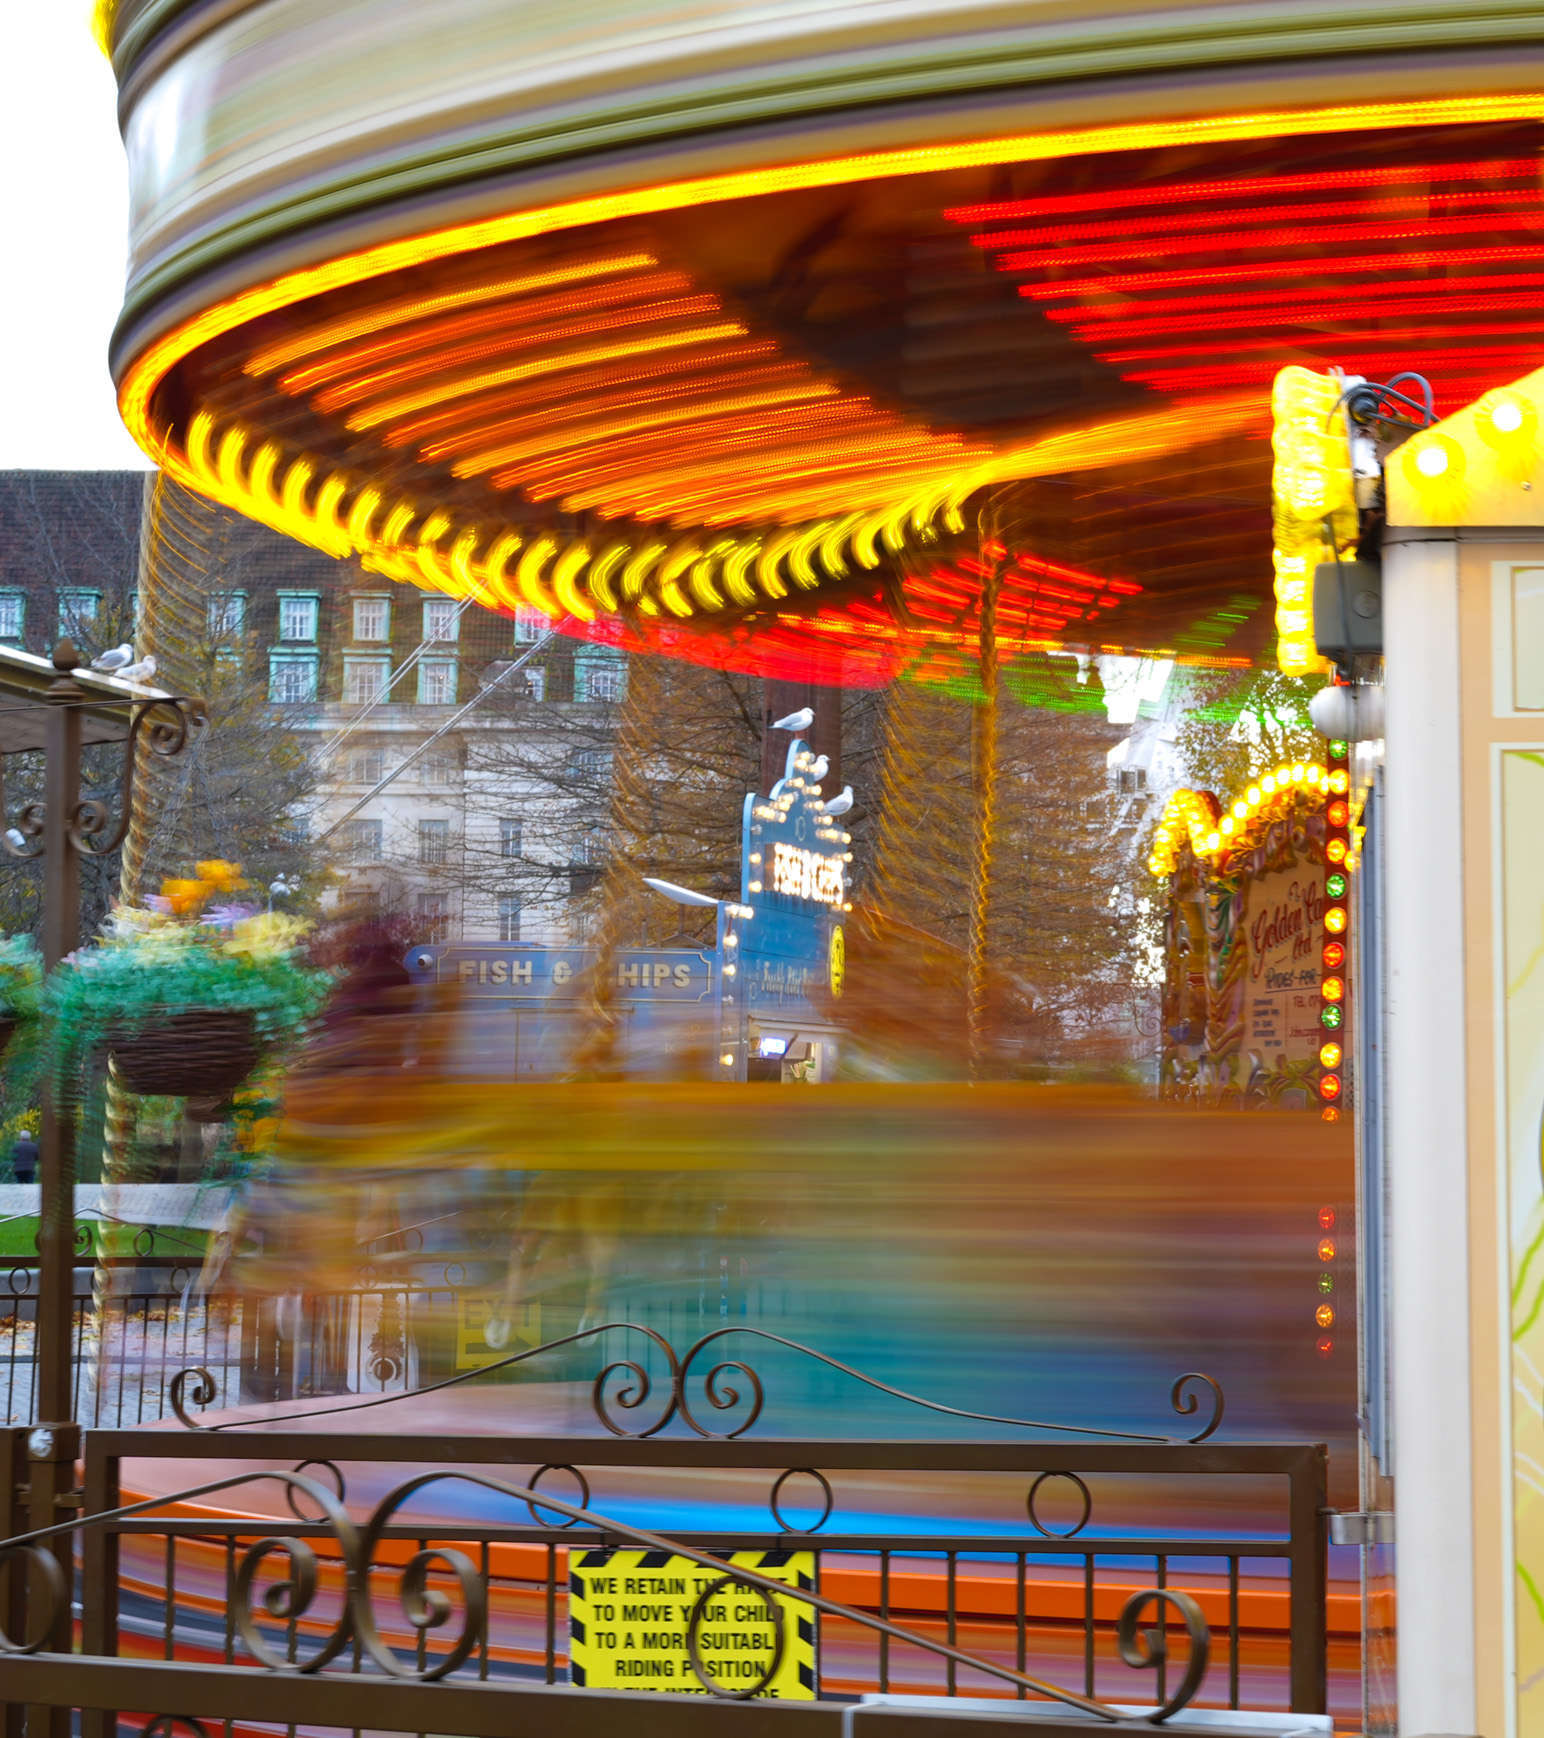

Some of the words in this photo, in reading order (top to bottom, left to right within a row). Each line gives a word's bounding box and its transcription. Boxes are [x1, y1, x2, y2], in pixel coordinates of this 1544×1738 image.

[458, 960, 532, 985] FISH
[553, 960, 573, 985] &
[616, 963, 691, 988] HIPS
[464, 1299, 537, 1330] EXT
[590, 1577, 617, 1595] WE
[625, 1577, 686, 1595] RETAIN
[593, 1605, 617, 1622] TO
[622, 1605, 673, 1622] MOVE
[680, 1605, 727, 1622] YUR
[594, 1632, 617, 1649] TO
[624, 1632, 635, 1649] A
[643, 1632, 693, 1649] MOR
[701, 1632, 781, 1650] SUITABL
[615, 1660, 674, 1677] RIDING
[682, 1660, 767, 1677] PSITION
